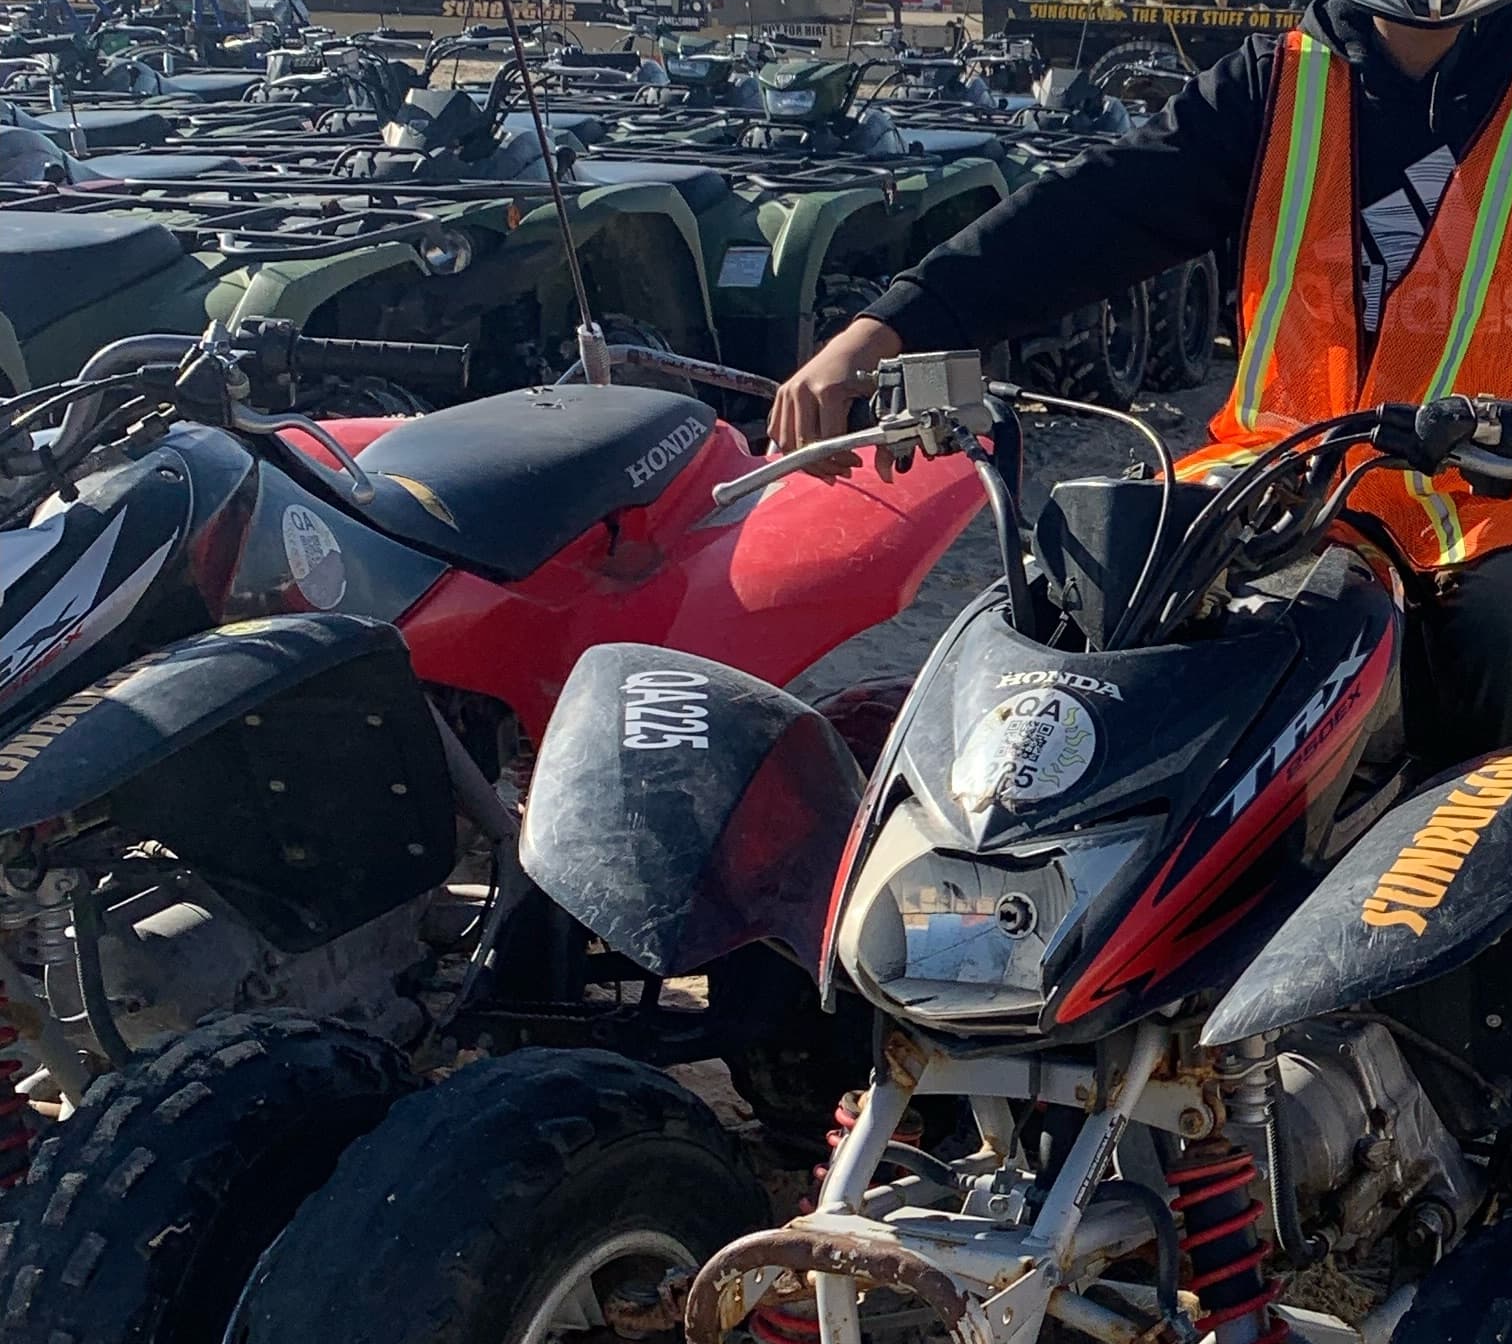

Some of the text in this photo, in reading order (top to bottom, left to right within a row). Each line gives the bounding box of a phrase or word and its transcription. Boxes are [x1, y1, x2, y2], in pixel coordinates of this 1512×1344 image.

[1132, 7, 1158, 23] THE
[1202, 11, 1245, 26] STUFF
[1250, 13, 1270, 27] ON
[624, 416, 708, 488] HONDA
[291, 511, 316, 531] QA
[996, 670, 1124, 702] HONDA
[618, 670, 710, 750] QA225
[1015, 696, 1062, 723] QA
[1206, 627, 1369, 823] TRX
